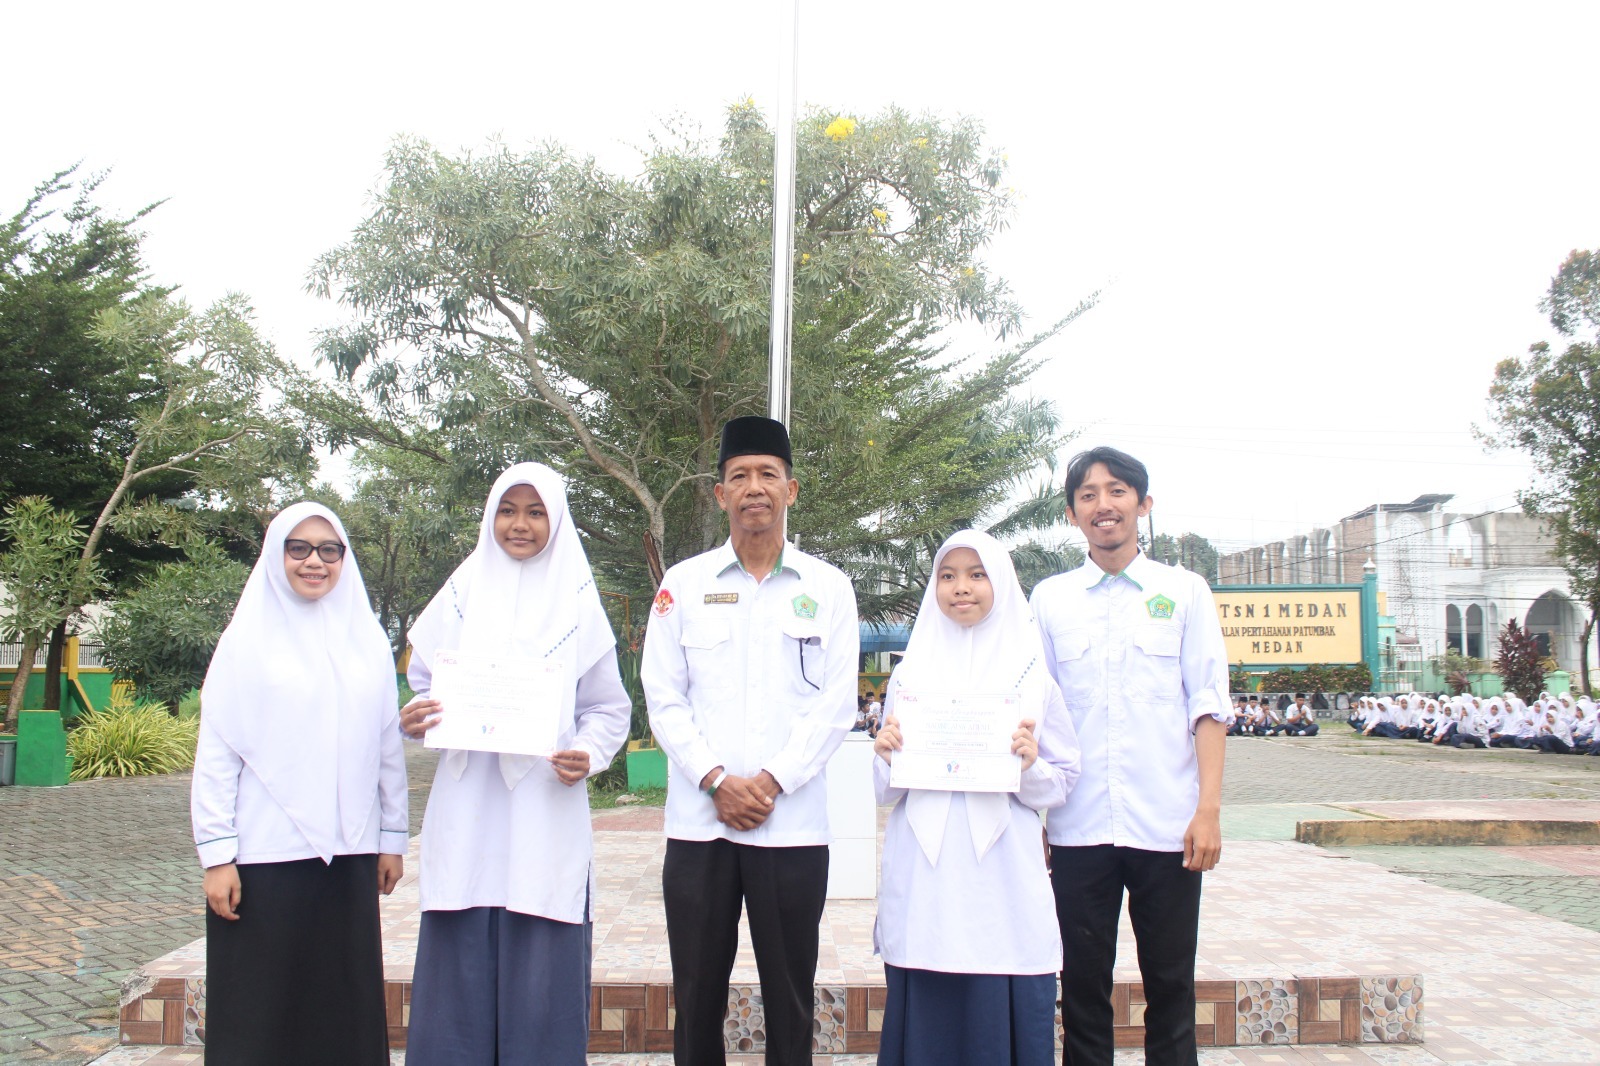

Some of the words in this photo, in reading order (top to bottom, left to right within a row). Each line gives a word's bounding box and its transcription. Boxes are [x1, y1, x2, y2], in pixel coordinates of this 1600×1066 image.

[1219, 604, 1255, 618] TsN
[1263, 604, 1271, 618] 1
[1278, 603, 1347, 618] MEDAN
[1221, 626, 1240, 637] ALAN
[1241, 626, 1292, 637] PERTAHANAN
[1293, 625, 1336, 637] PATUMBAK
[1252, 640, 1303, 654] MEDAN
